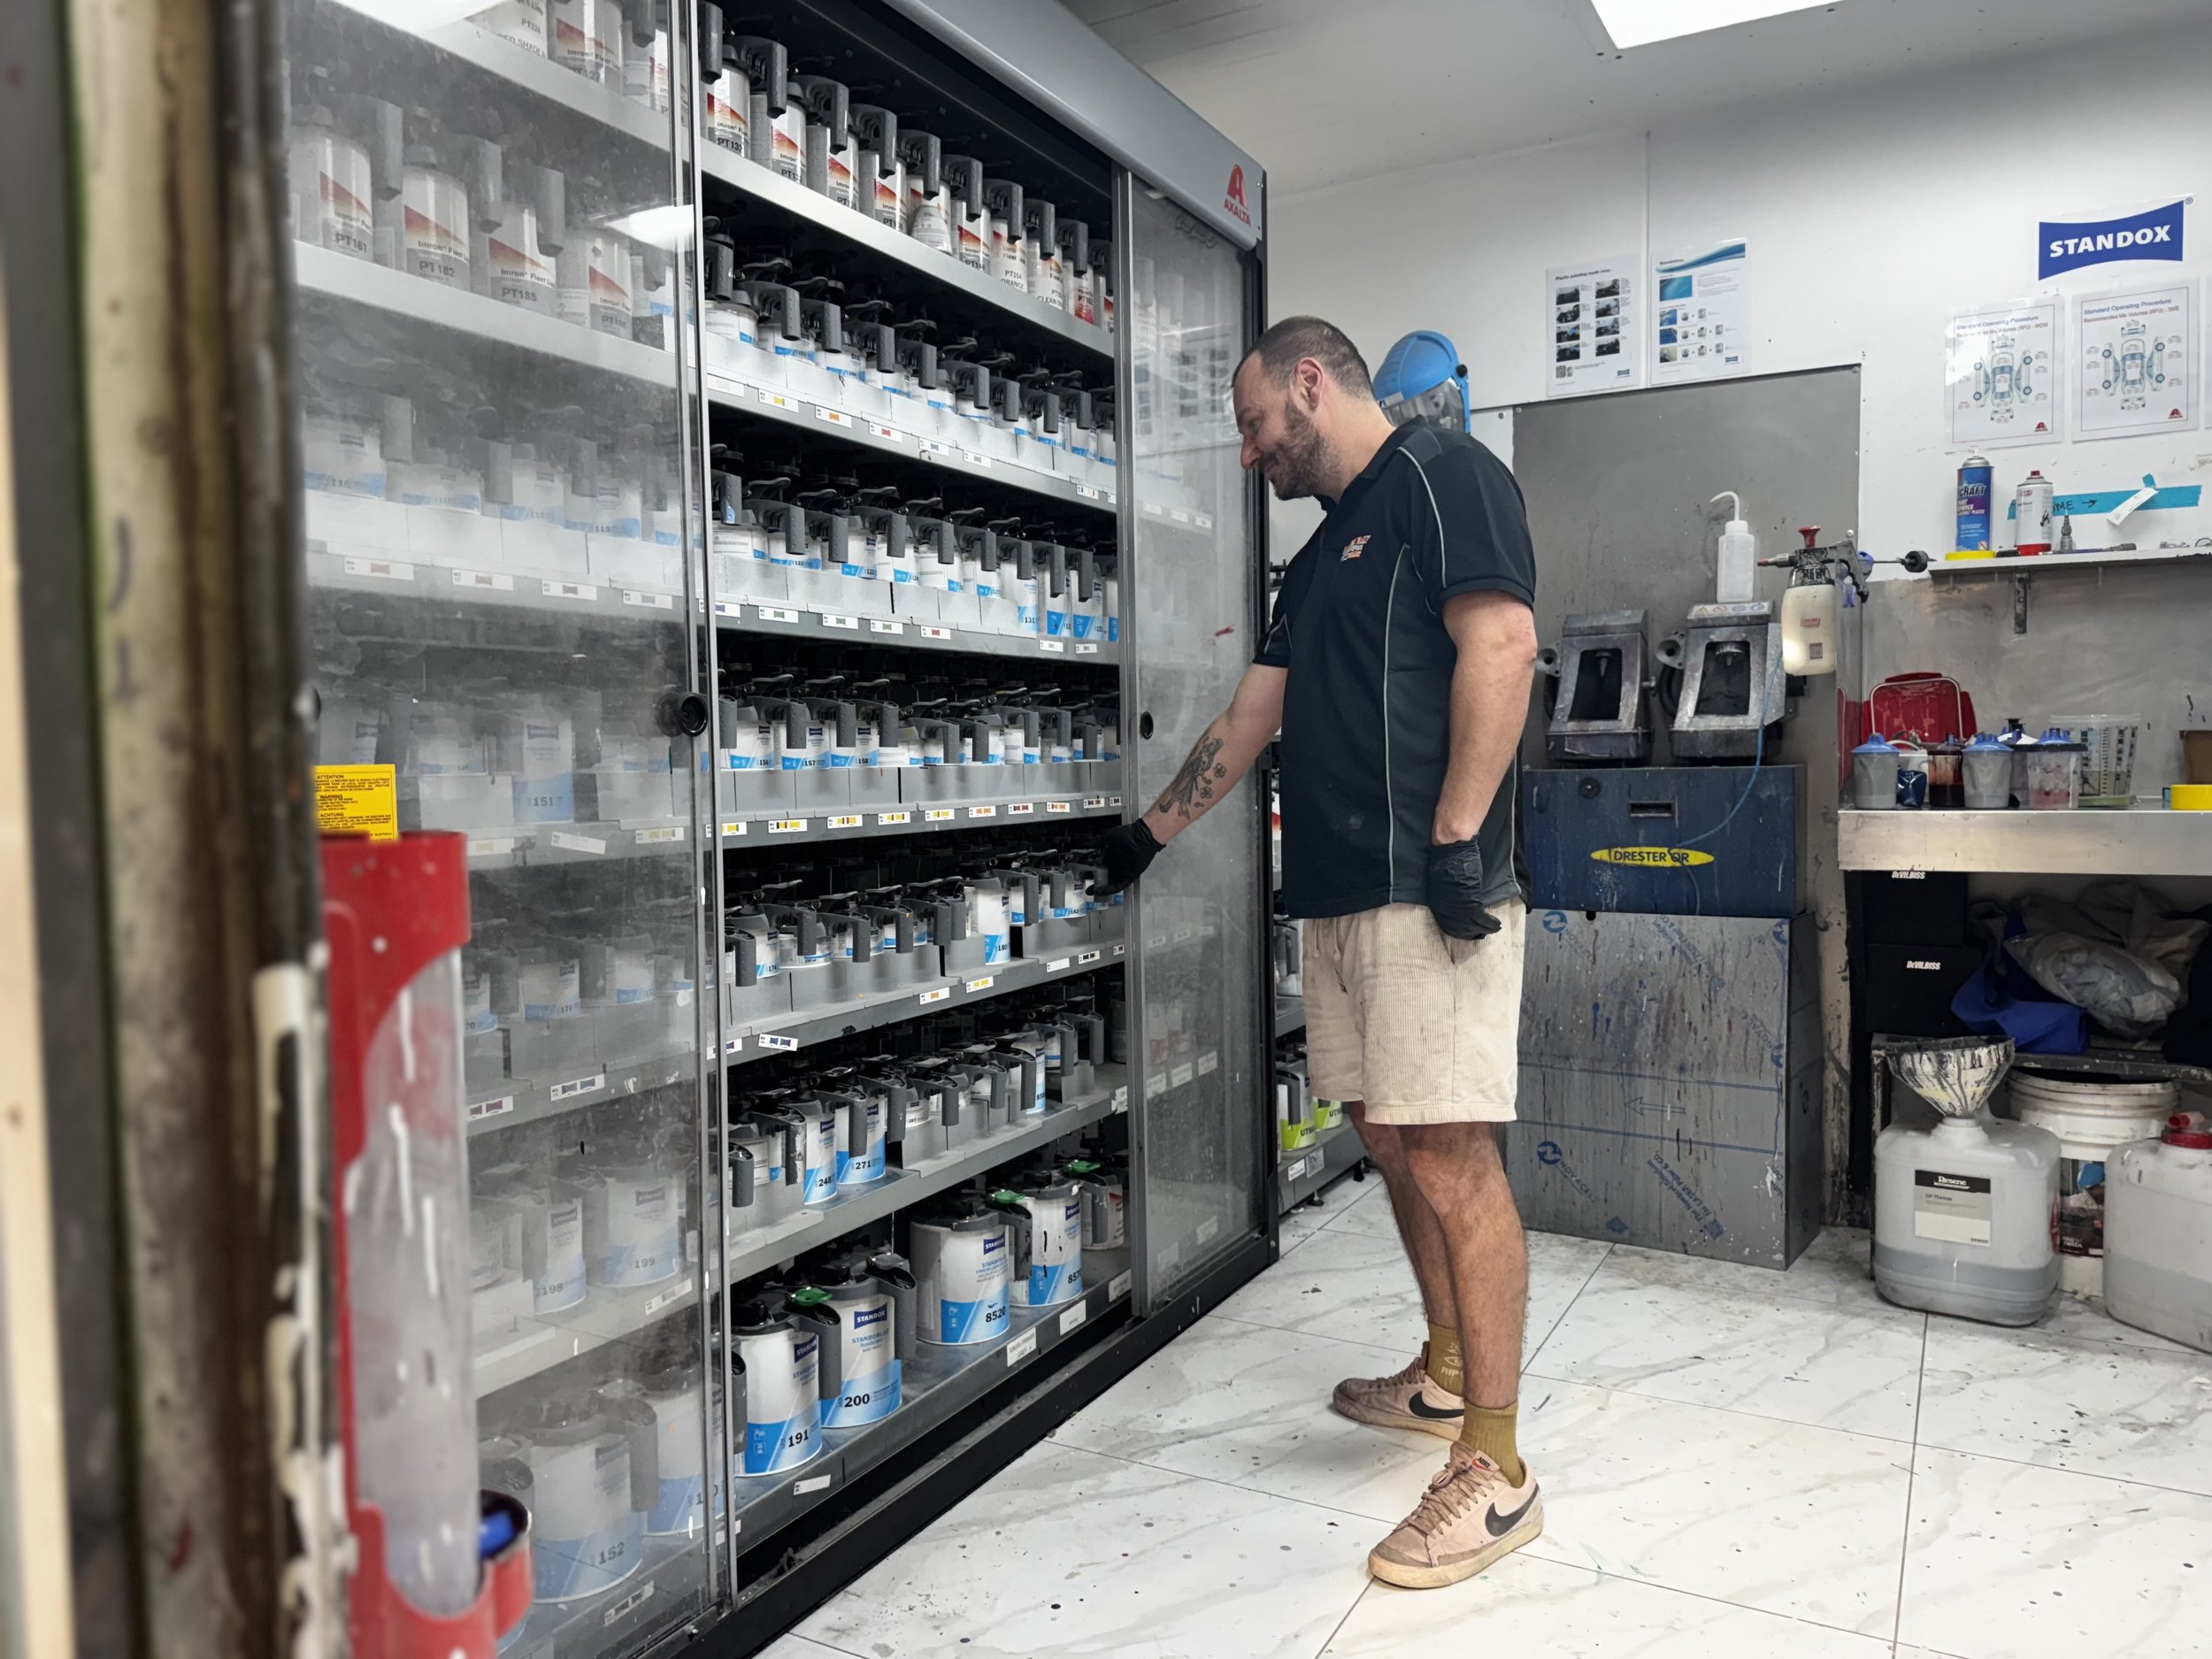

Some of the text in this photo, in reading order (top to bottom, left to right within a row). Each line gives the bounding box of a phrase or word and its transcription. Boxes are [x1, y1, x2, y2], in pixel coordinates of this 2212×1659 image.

[335, 233, 367, 253] PT181
[2050, 225, 2171, 257] STANDOX
[419, 260, 455, 278] PT182
[2111, 302, 2139, 311] Operating
[2141, 298, 2171, 307] Procedure
[533, 796, 554, 807] 151
[1614, 850, 1667, 862] DRESTER
[856, 1161, 871, 1170] 271
[1938, 1176, 1966, 1186] Resene
[1681, 1184, 1704, 1207] LASER
[635, 1257, 656, 1268] 199
[542, 1283, 564, 1296] 198
[856, 1310, 885, 1323] STANDOX
[986, 1306, 1006, 1322] 8520
[844, 1394, 870, 1408] 200
[788, 1429, 809, 1448] 191
[599, 1542, 625, 1565] 152
